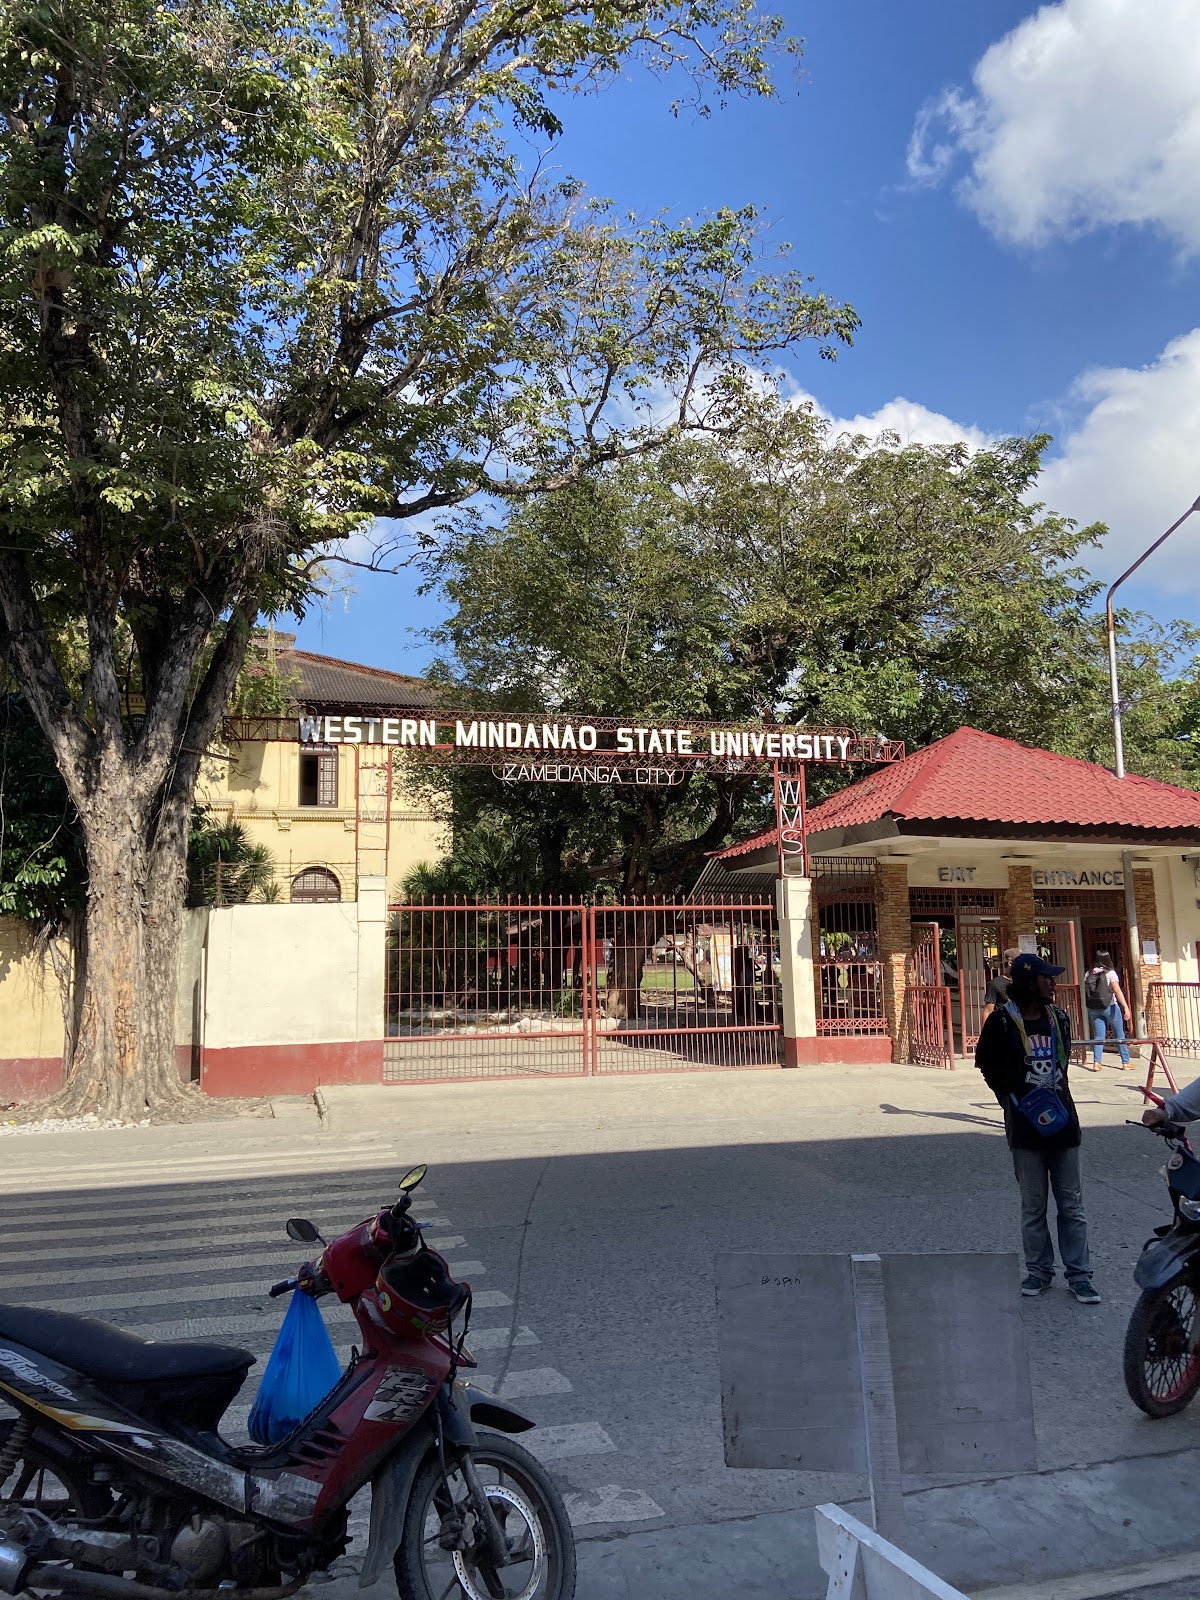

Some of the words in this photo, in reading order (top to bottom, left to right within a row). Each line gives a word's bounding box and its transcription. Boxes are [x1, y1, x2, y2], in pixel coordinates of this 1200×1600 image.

[299, 716, 436, 746] WESTERN
[455, 720, 597, 750] MINDANAO
[616, 728, 692, 754] STATE
[711, 731, 850, 760] UNIVERSITY
[503, 763, 622, 783] ZAMBOANGA
[635, 768, 677, 786] CITY
[779, 780, 804, 877] WMSU
[938, 866, 976, 882] EXIT
[1033, 870, 1123, 886] ENTRANCE
